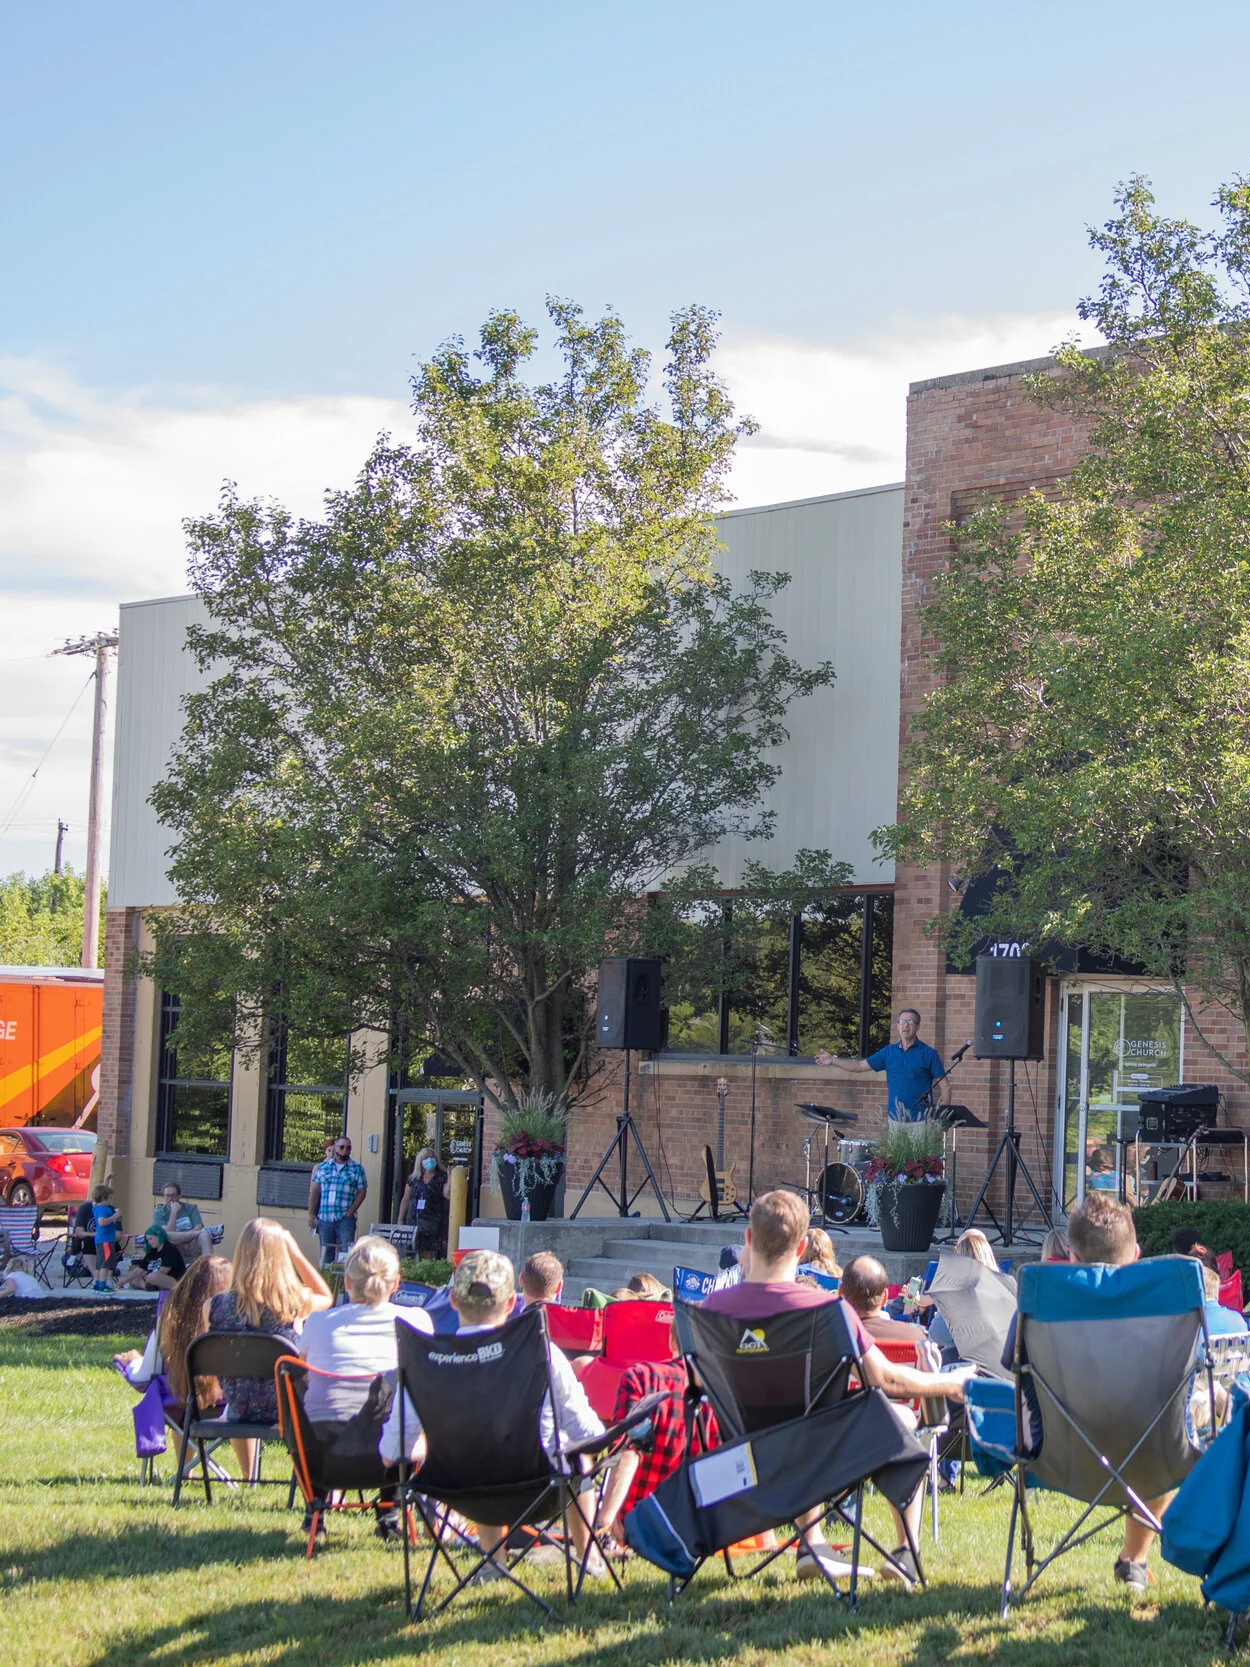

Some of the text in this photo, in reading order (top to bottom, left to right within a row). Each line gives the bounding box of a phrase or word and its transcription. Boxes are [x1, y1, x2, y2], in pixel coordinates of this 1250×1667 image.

[990, 942, 1030, 957] 170
[1130, 1040, 1167, 1048] GENESIS
[428, 1351, 478, 1365] experience
